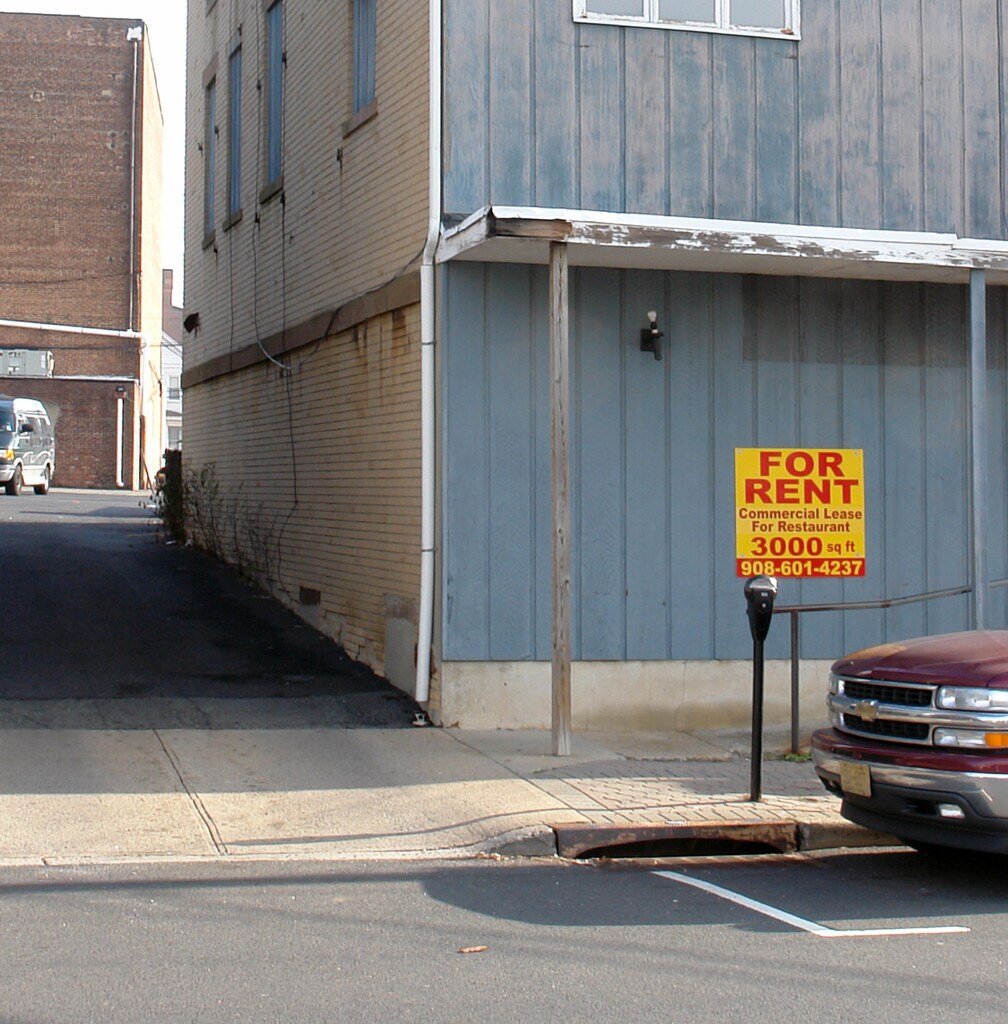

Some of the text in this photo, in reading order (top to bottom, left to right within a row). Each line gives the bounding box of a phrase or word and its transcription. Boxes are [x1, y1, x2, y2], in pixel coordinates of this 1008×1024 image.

[760, 451, 845, 477] FOR
[745, 478, 859, 504] RENT
[739, 508, 862, 520] Commercial Lease
[752, 521, 850, 532] For Restaurant
[751, 537, 855, 556] 3000 sq ft
[741, 561, 862, 576] 908-601-4237
